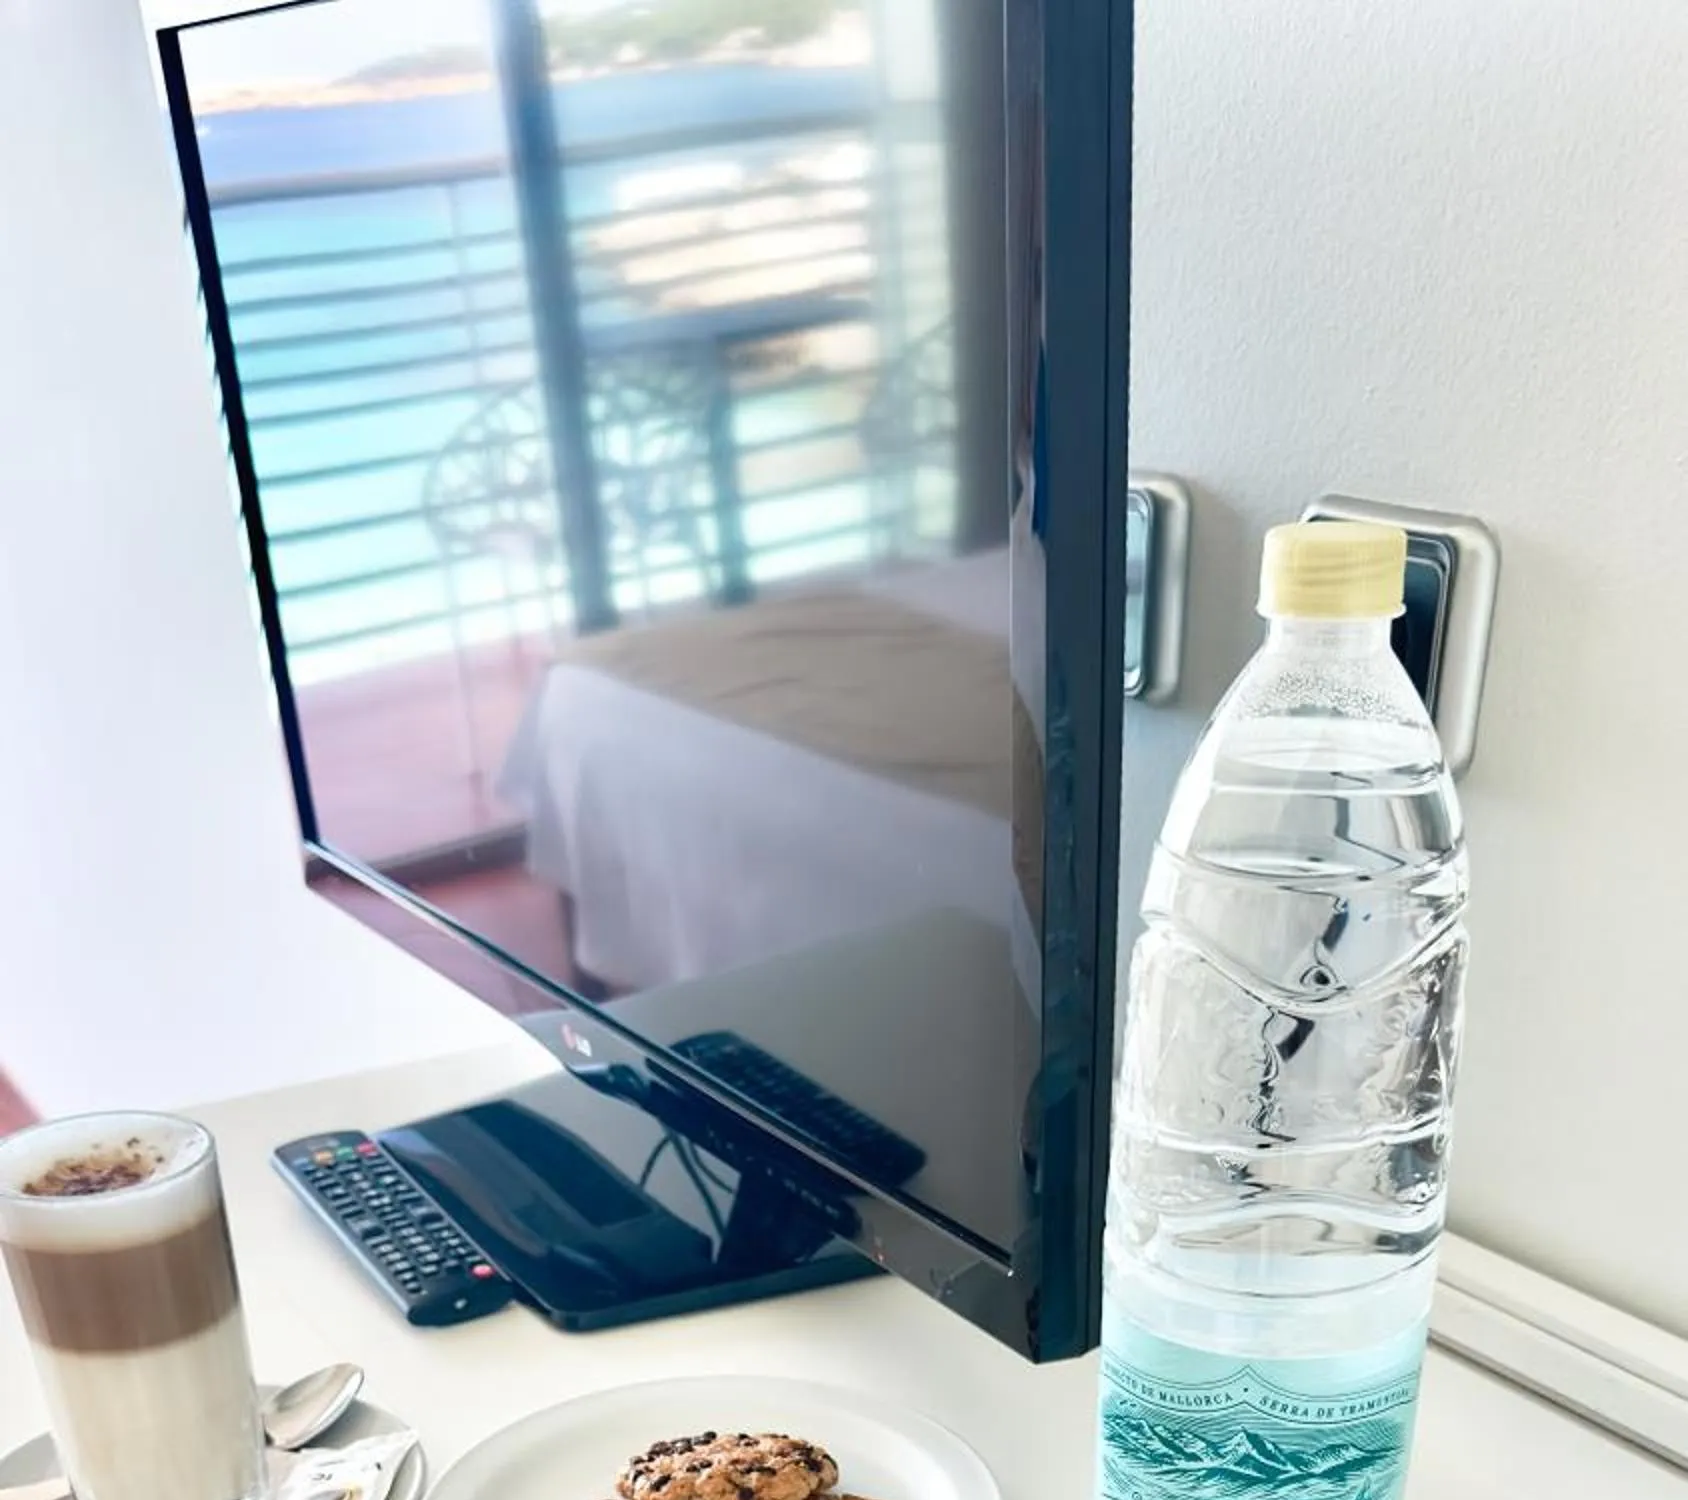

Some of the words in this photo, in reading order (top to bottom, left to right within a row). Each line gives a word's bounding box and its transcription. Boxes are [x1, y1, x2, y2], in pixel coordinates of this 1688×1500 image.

[1159, 1391, 1233, 1407] MALLORCA
[1259, 1395, 1309, 1417] SERRA
[1317, 1407, 1334, 1418] DE
